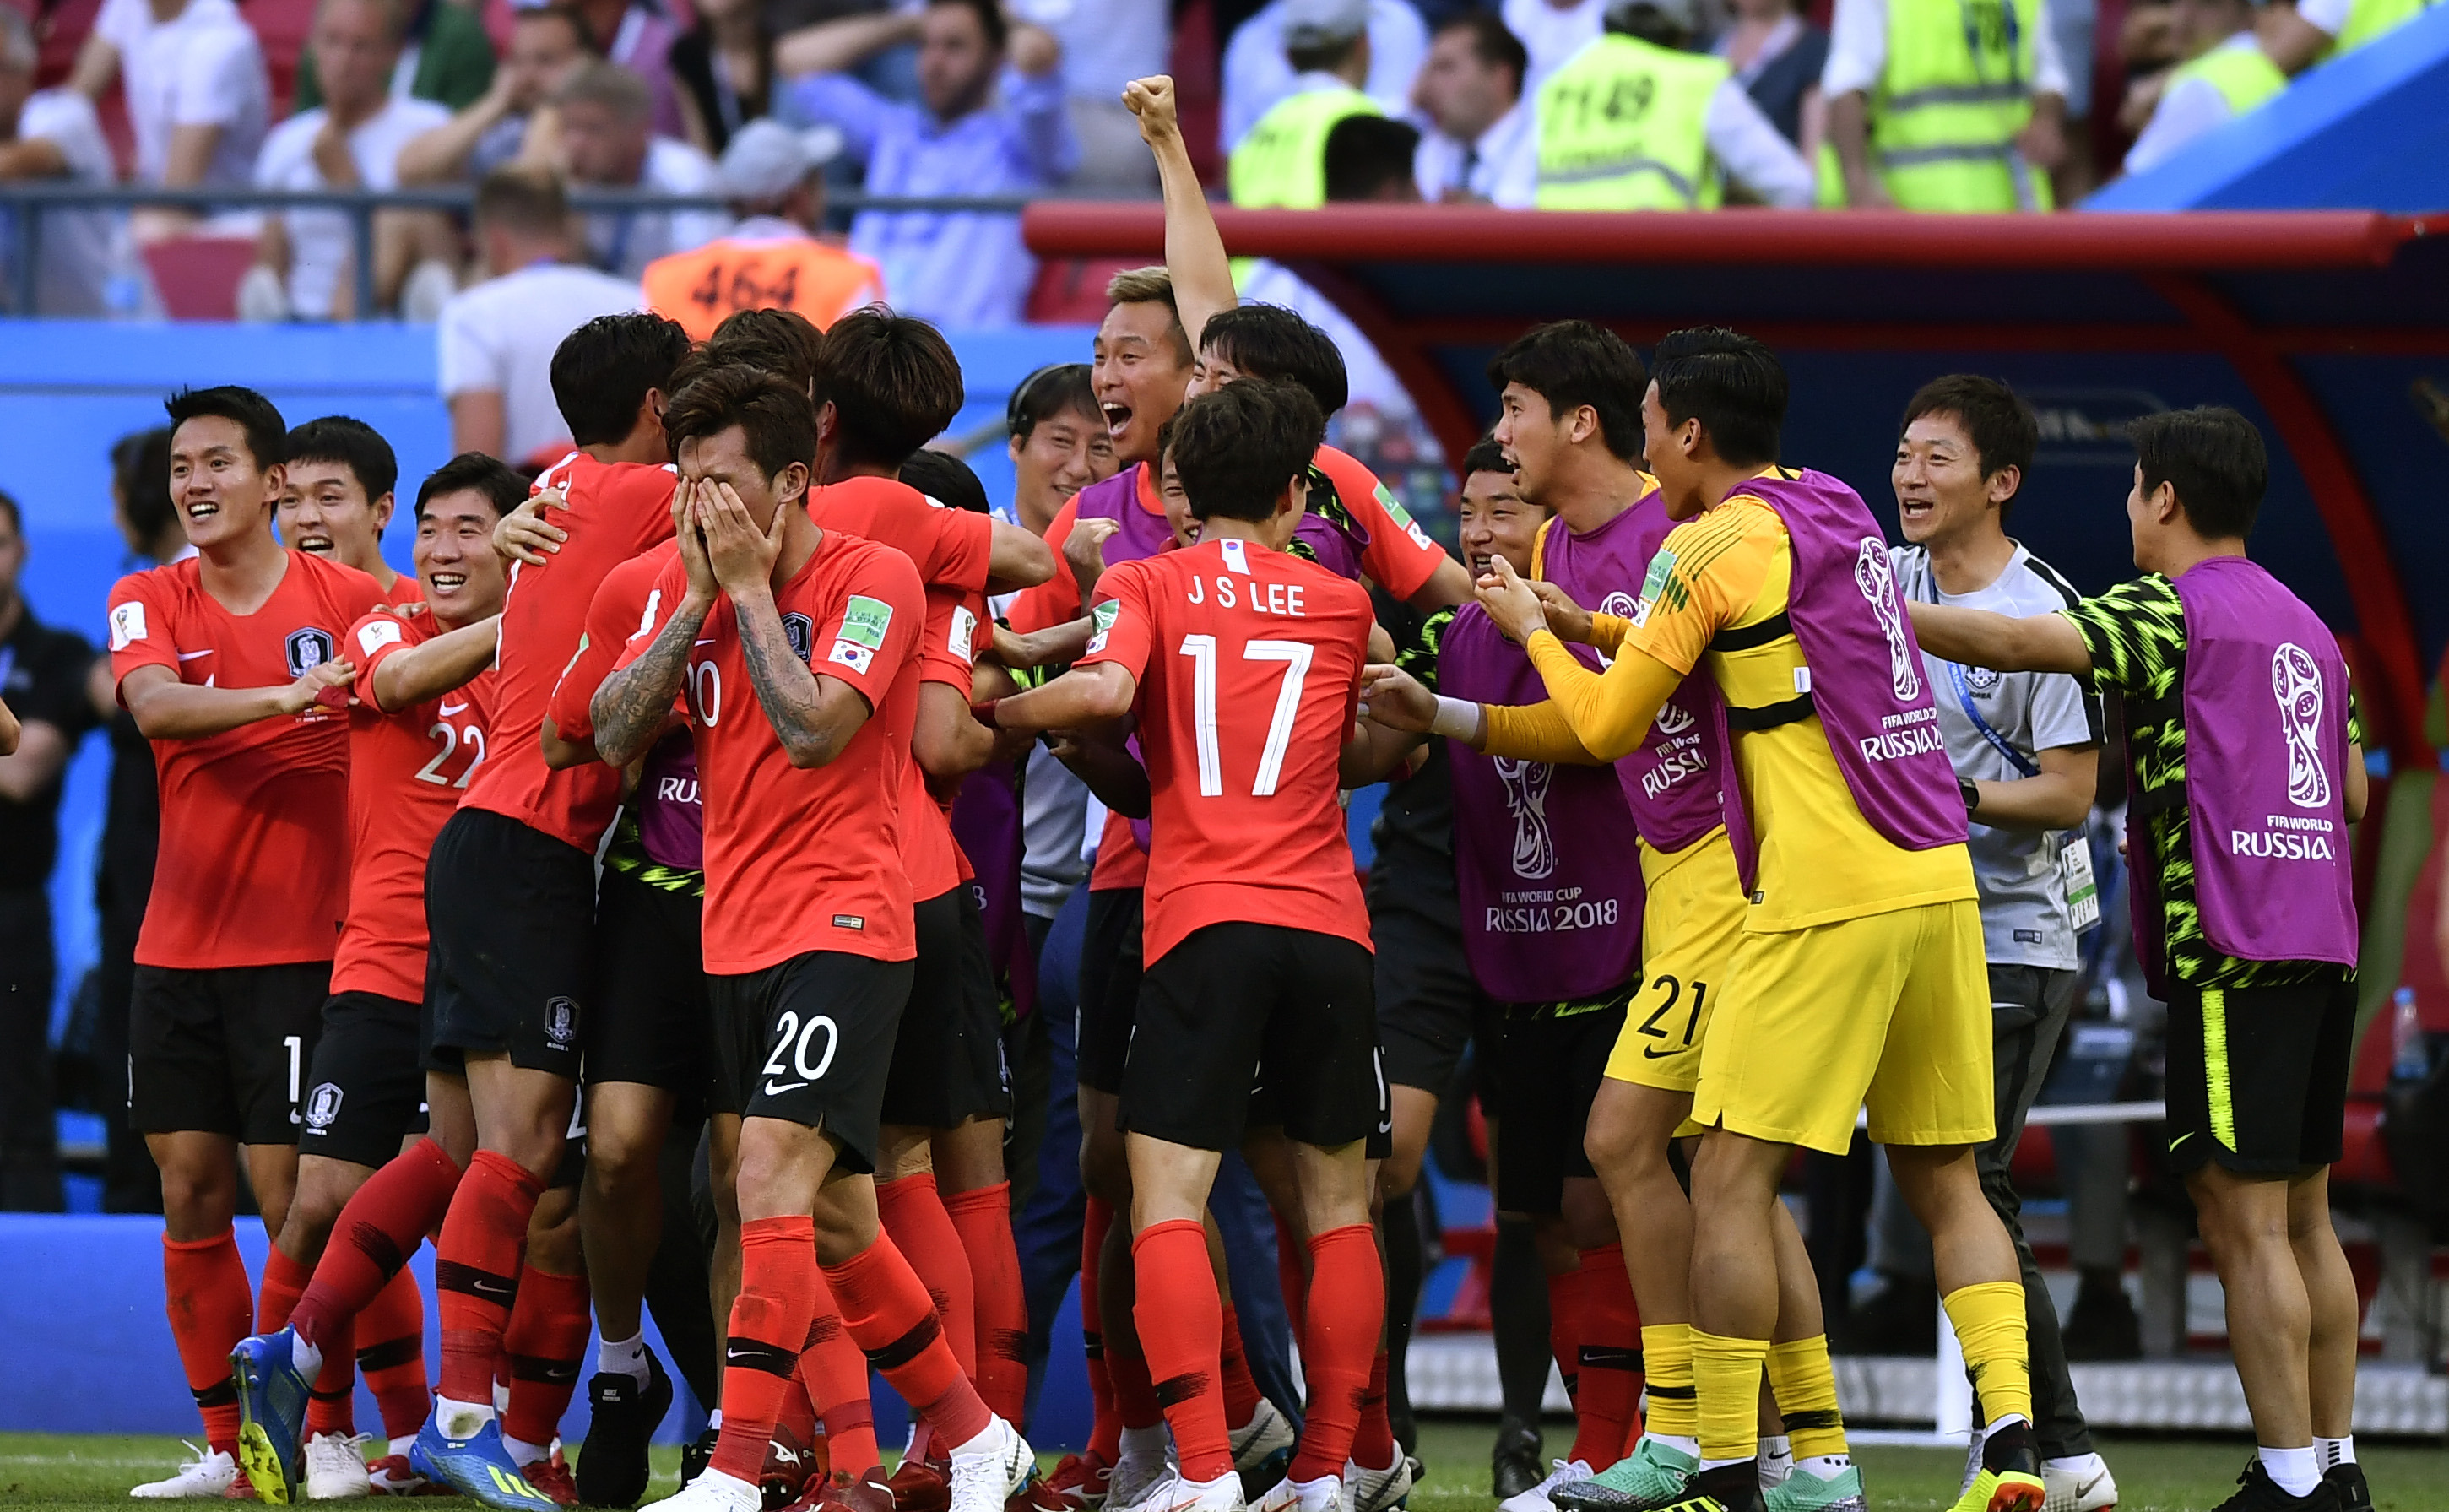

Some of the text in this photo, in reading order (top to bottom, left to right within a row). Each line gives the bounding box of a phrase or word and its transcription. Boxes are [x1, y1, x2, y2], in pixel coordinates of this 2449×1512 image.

[692, 264, 800, 311] 464
[1187, 575, 1306, 616] J S LEE
[686, 660, 721, 728] 0
[1178, 633, 1314, 796] 17
[1882, 713, 1904, 729] FIFA
[414, 722, 485, 789] 22
[1860, 727, 1935, 764] RUSSIA
[658, 777, 702, 805] RU
[1642, 748, 1708, 800] RUSSI
[2267, 815, 2333, 832] FIFA WORLD
[2231, 830, 2333, 860] RUSSIA
[1517, 890, 1554, 903] WORLD
[1555, 886, 1583, 902] CUP
[1554, 899, 1617, 931] 2018
[1636, 974, 1707, 1046] 21
[762, 1011, 838, 1081] 20
